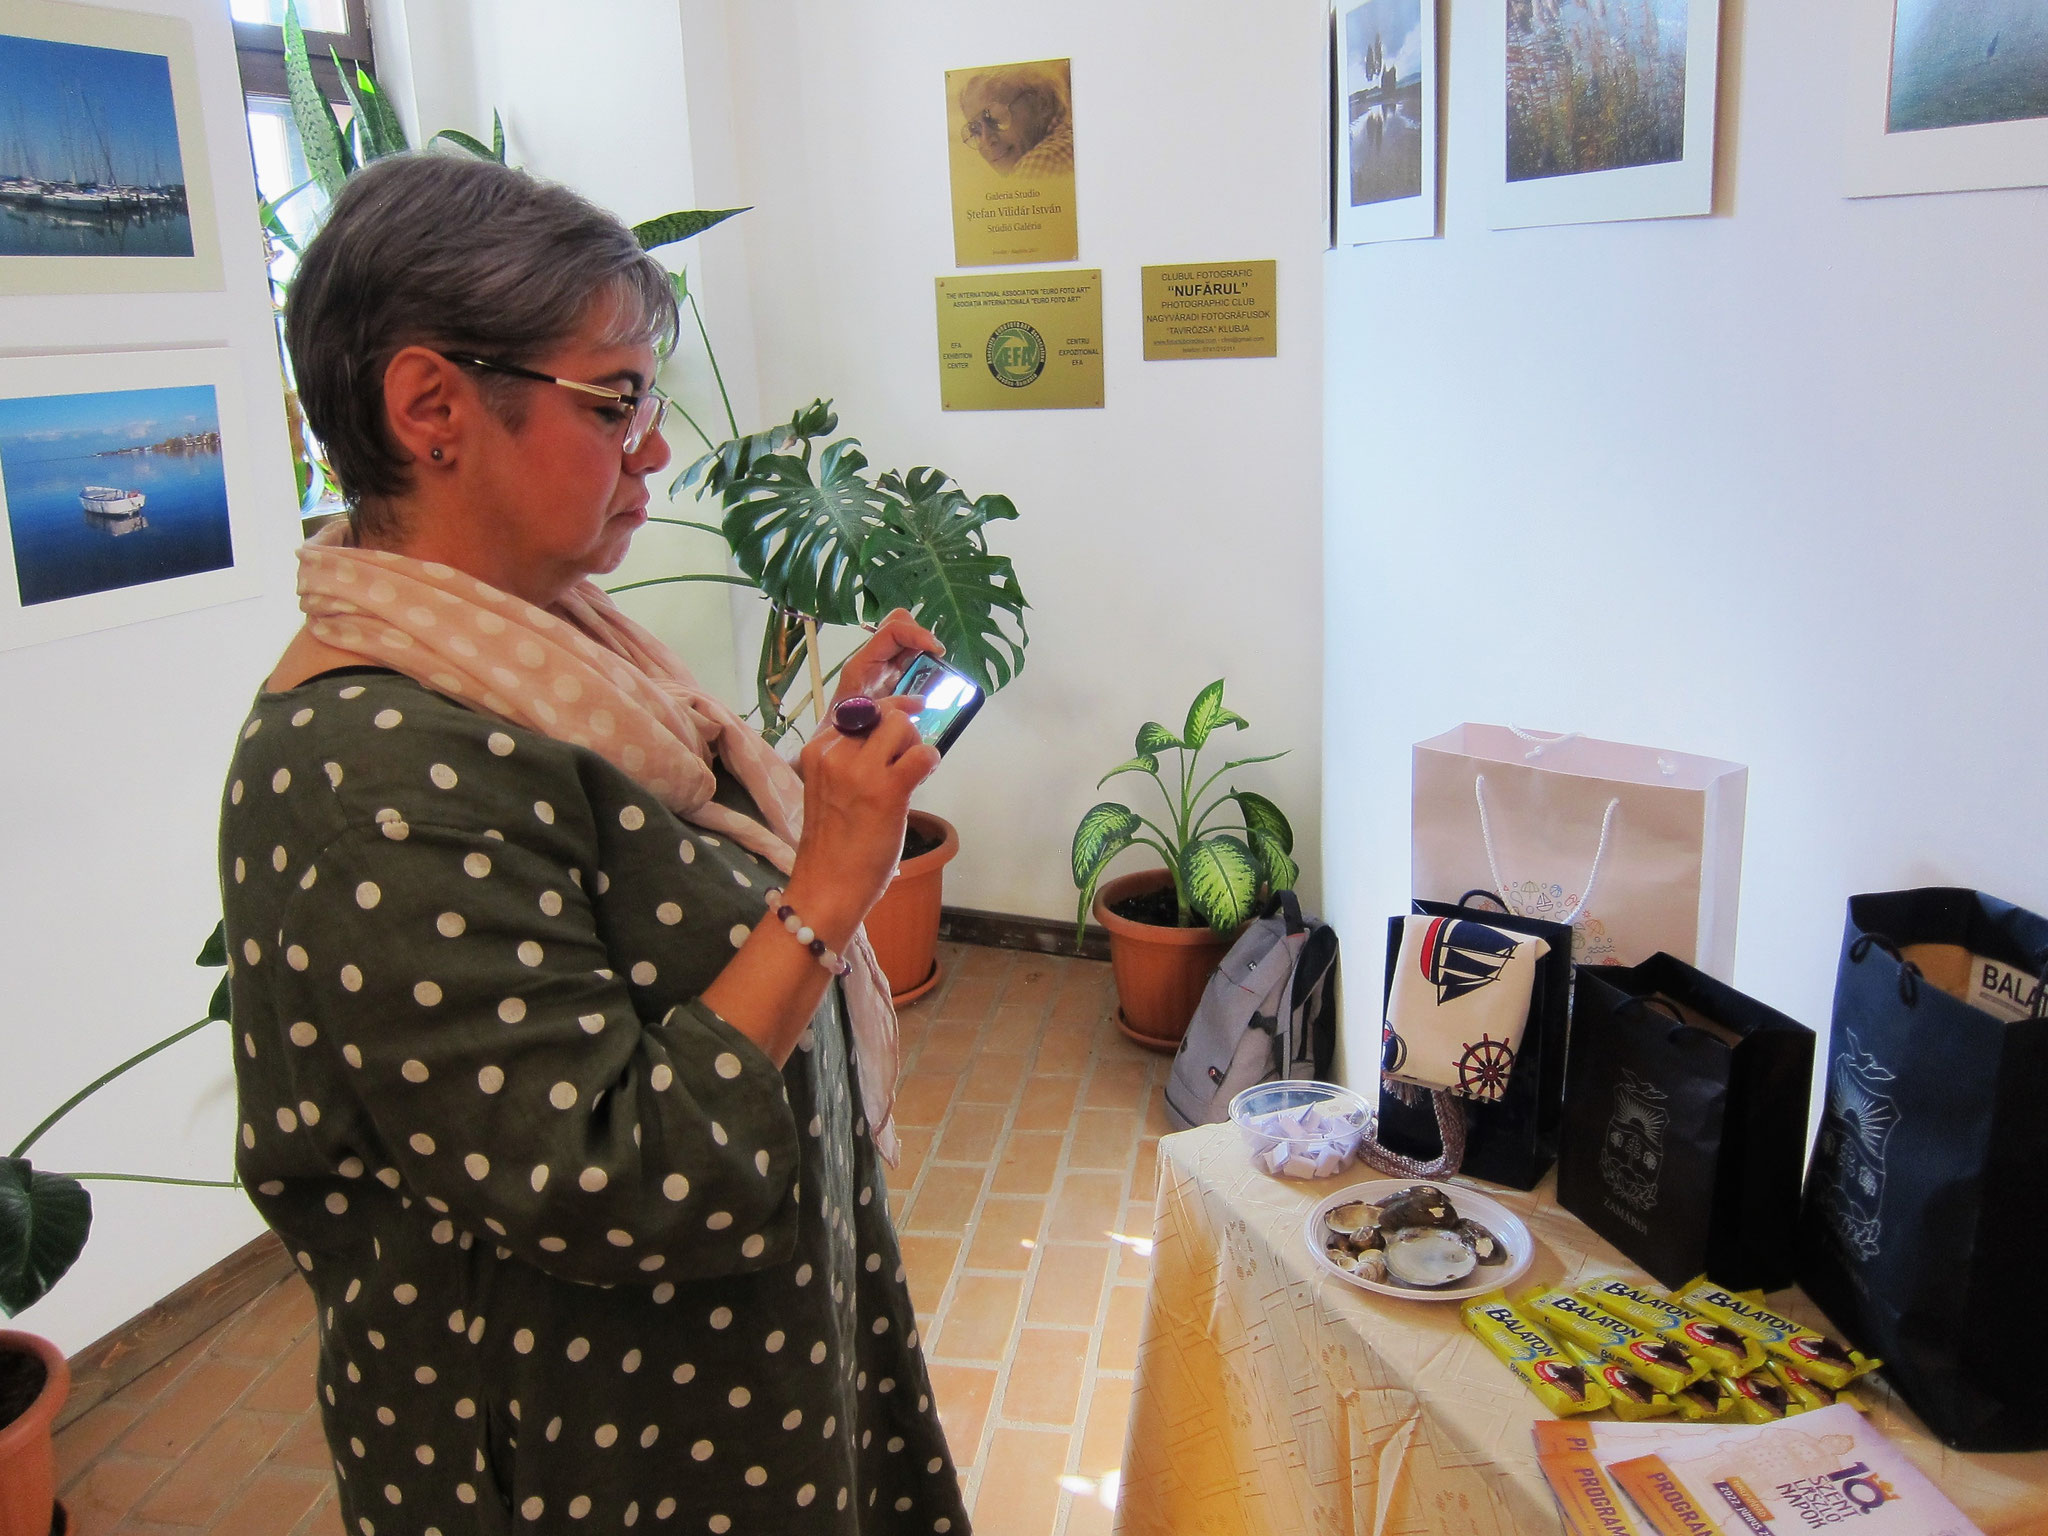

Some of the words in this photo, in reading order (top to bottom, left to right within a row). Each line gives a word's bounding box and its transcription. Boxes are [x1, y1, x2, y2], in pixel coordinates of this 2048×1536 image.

[1015, 188, 1041, 199] Studio
[1032, 203, 1062, 215] István
[1161, 271, 1194, 281] CLUBUL
[1196, 269, 1253, 279] FOTOGRAFIC
[958, 291, 1000, 299] INTERNATIONAL
[1002, 289, 1039, 297] ASSOCIATION
[1161, 299, 1229, 309] PHOTOGRAPHIC
[1231, 297, 1255, 306] CLUB
[1218, 324, 1250, 333] KLUBJA
[1003, 346, 1034, 368] EFA
[1603, 1282, 1698, 1320] BALATON
[1551, 1297, 1644, 1339] BALATON
[1705, 1291, 1802, 1334] BALATON
[1485, 1308, 1560, 1357] BALATON
[1776, 1484, 1827, 1529] NAPOK
[1808, 1475, 1861, 1517] SZENT
